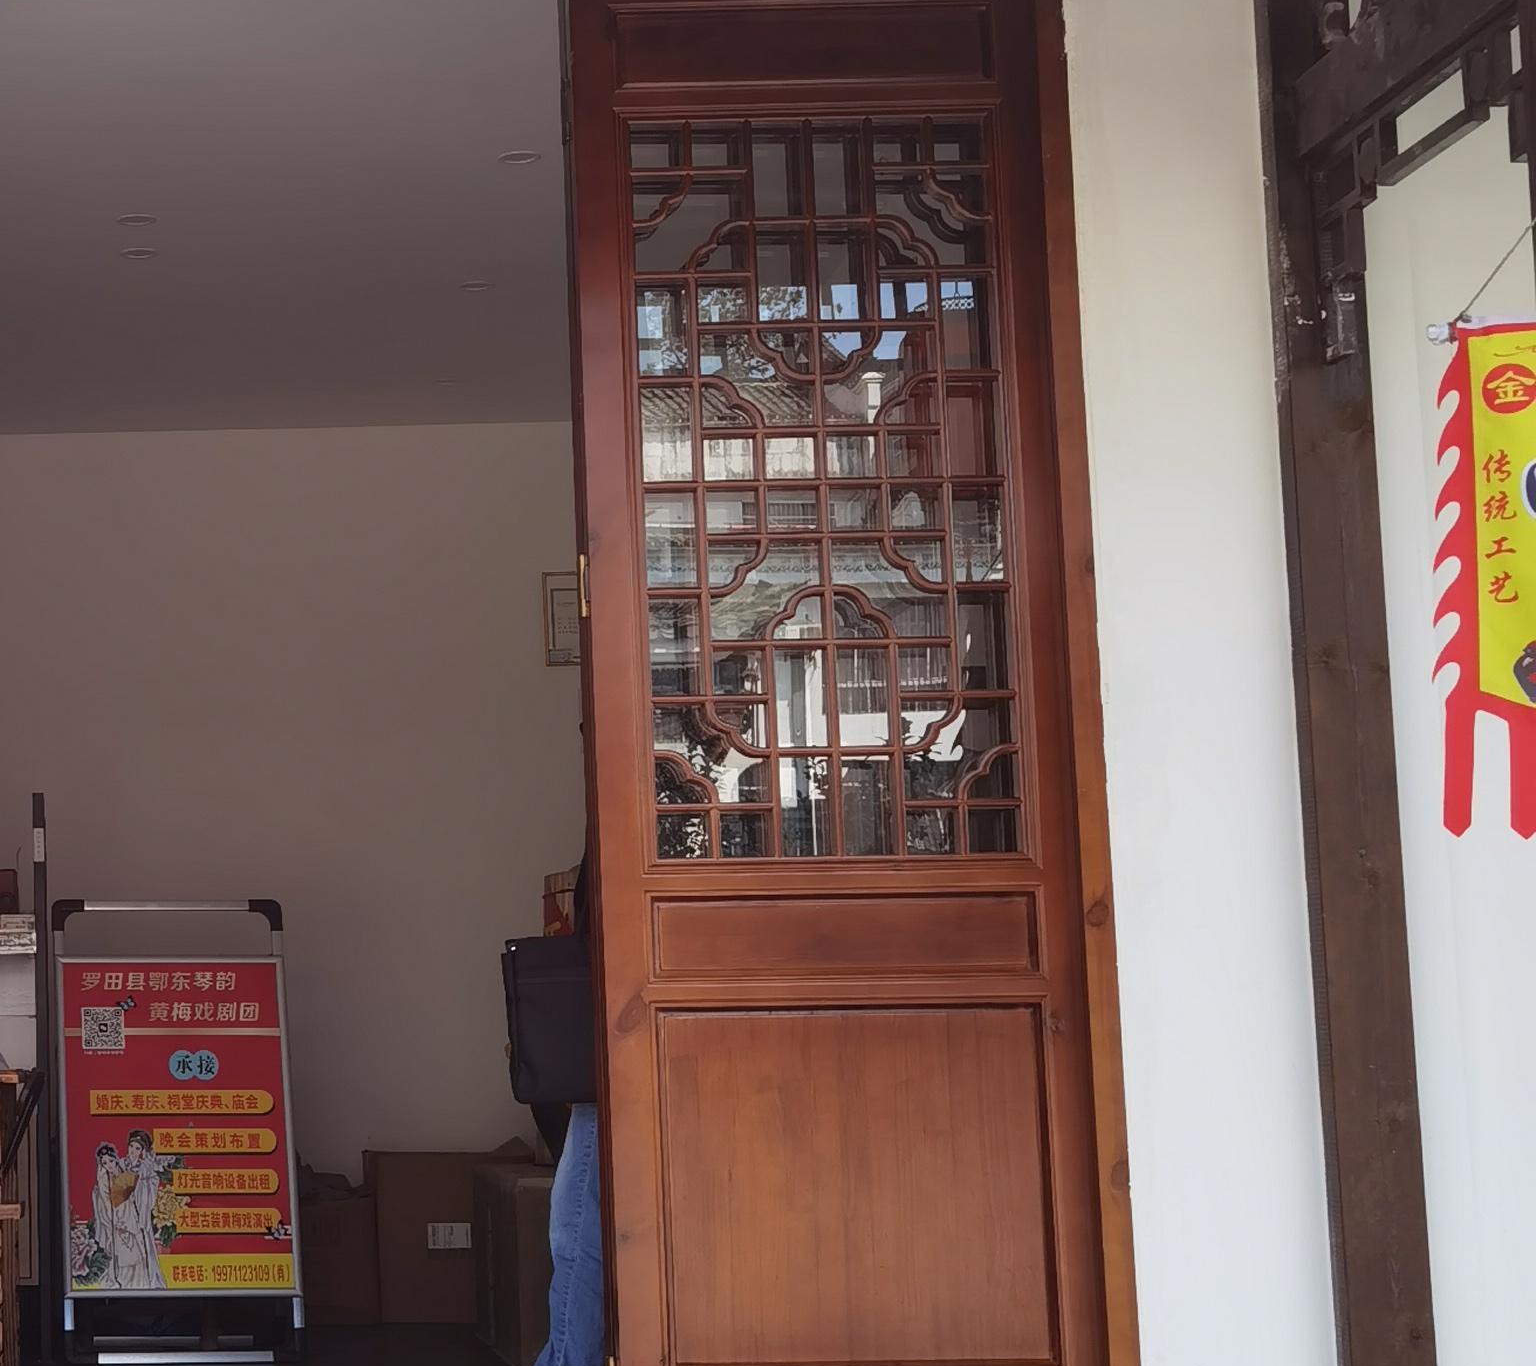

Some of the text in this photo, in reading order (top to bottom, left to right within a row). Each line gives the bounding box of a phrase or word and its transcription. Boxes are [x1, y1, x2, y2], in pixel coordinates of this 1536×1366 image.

[1486, 370, 1536, 405] 金
[1482, 449, 1519, 604] 传统工艺
[80, 972, 236, 991] 罗田县鄂东琴韵
[148, 1002, 260, 1022] 黄梅戏剧团
[175, 1055, 215, 1075] 承接
[95, 1094, 259, 1111] 婚庆、寿庆、祠堂庆典、庙会
[159, 1133, 262, 1149] 晚会策划布置
[177, 1172, 272, 1190] 灯光音响设备出租
[178, 1211, 273, 1229] 大型古装黄梅戏演出
